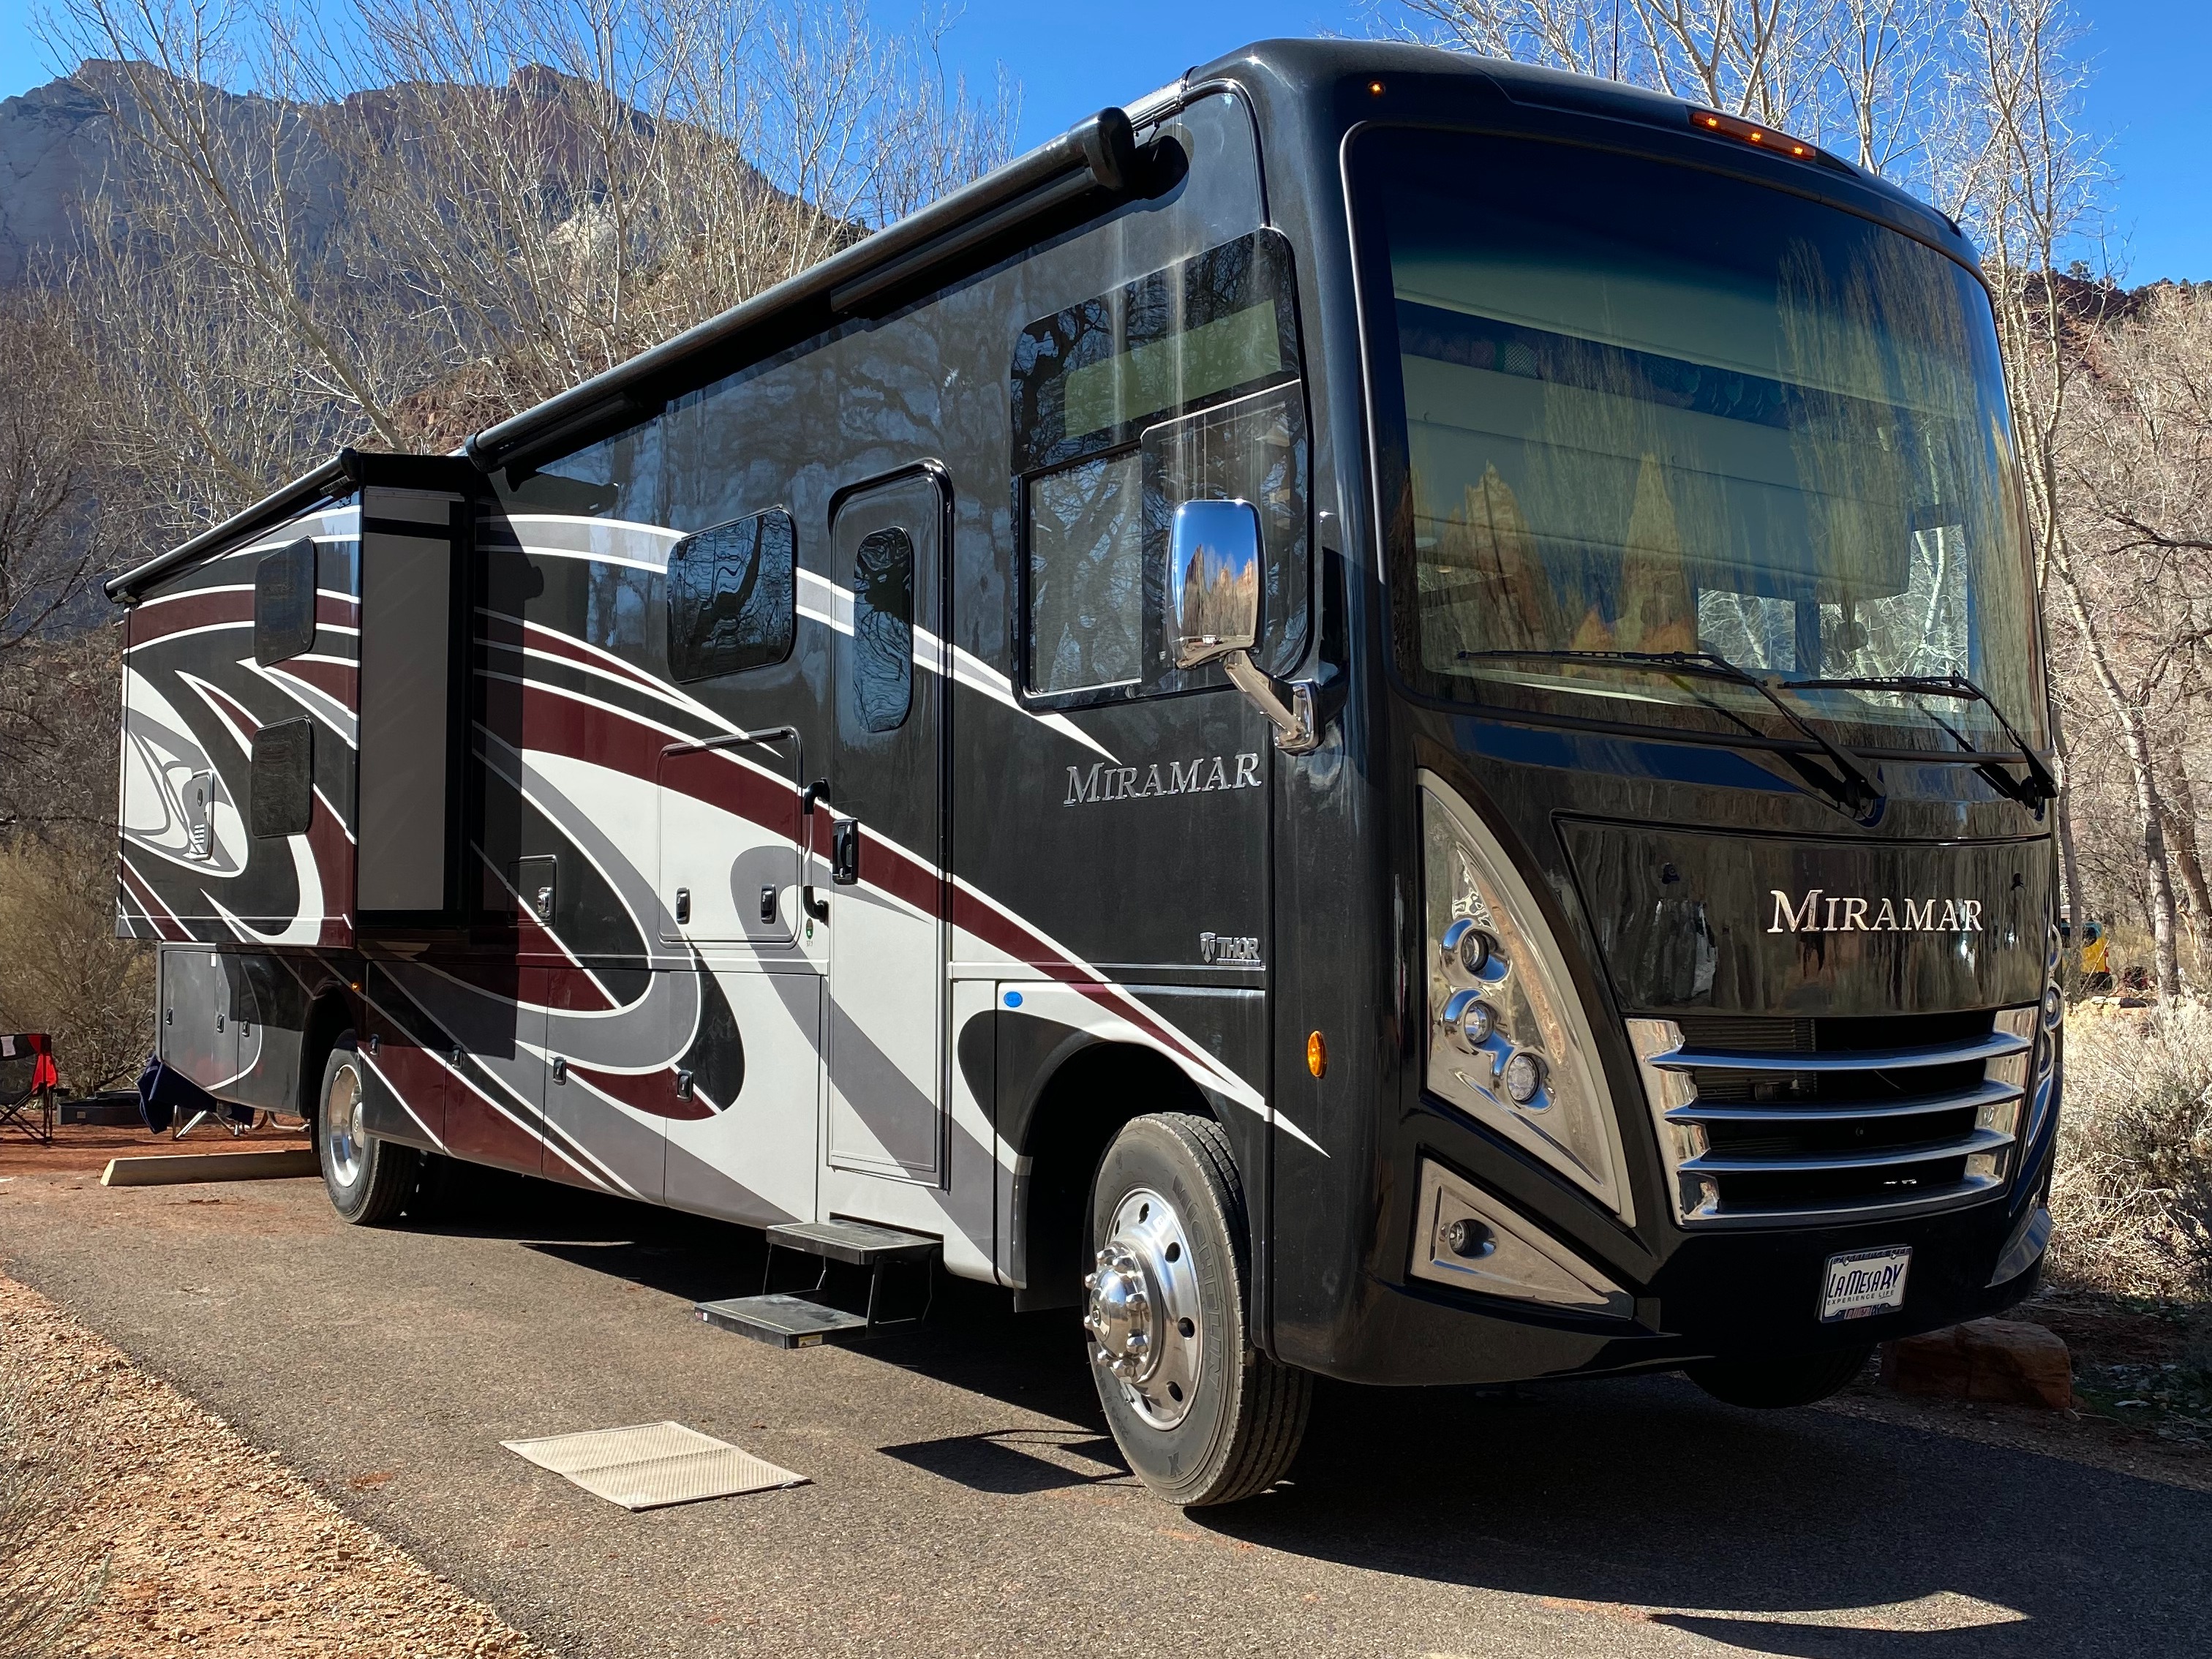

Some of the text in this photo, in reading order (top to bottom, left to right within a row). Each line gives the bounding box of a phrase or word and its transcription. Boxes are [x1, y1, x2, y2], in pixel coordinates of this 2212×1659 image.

[1064, 753, 1263, 805] MIRAMAR
[1767, 889, 1983, 933] MIRAMAR
[1216, 937, 1260, 960] THOR
[1173, 1175, 1222, 1387] MICHELIN
[1827, 1290, 1895, 1306] EXPERIENCE LIFE
